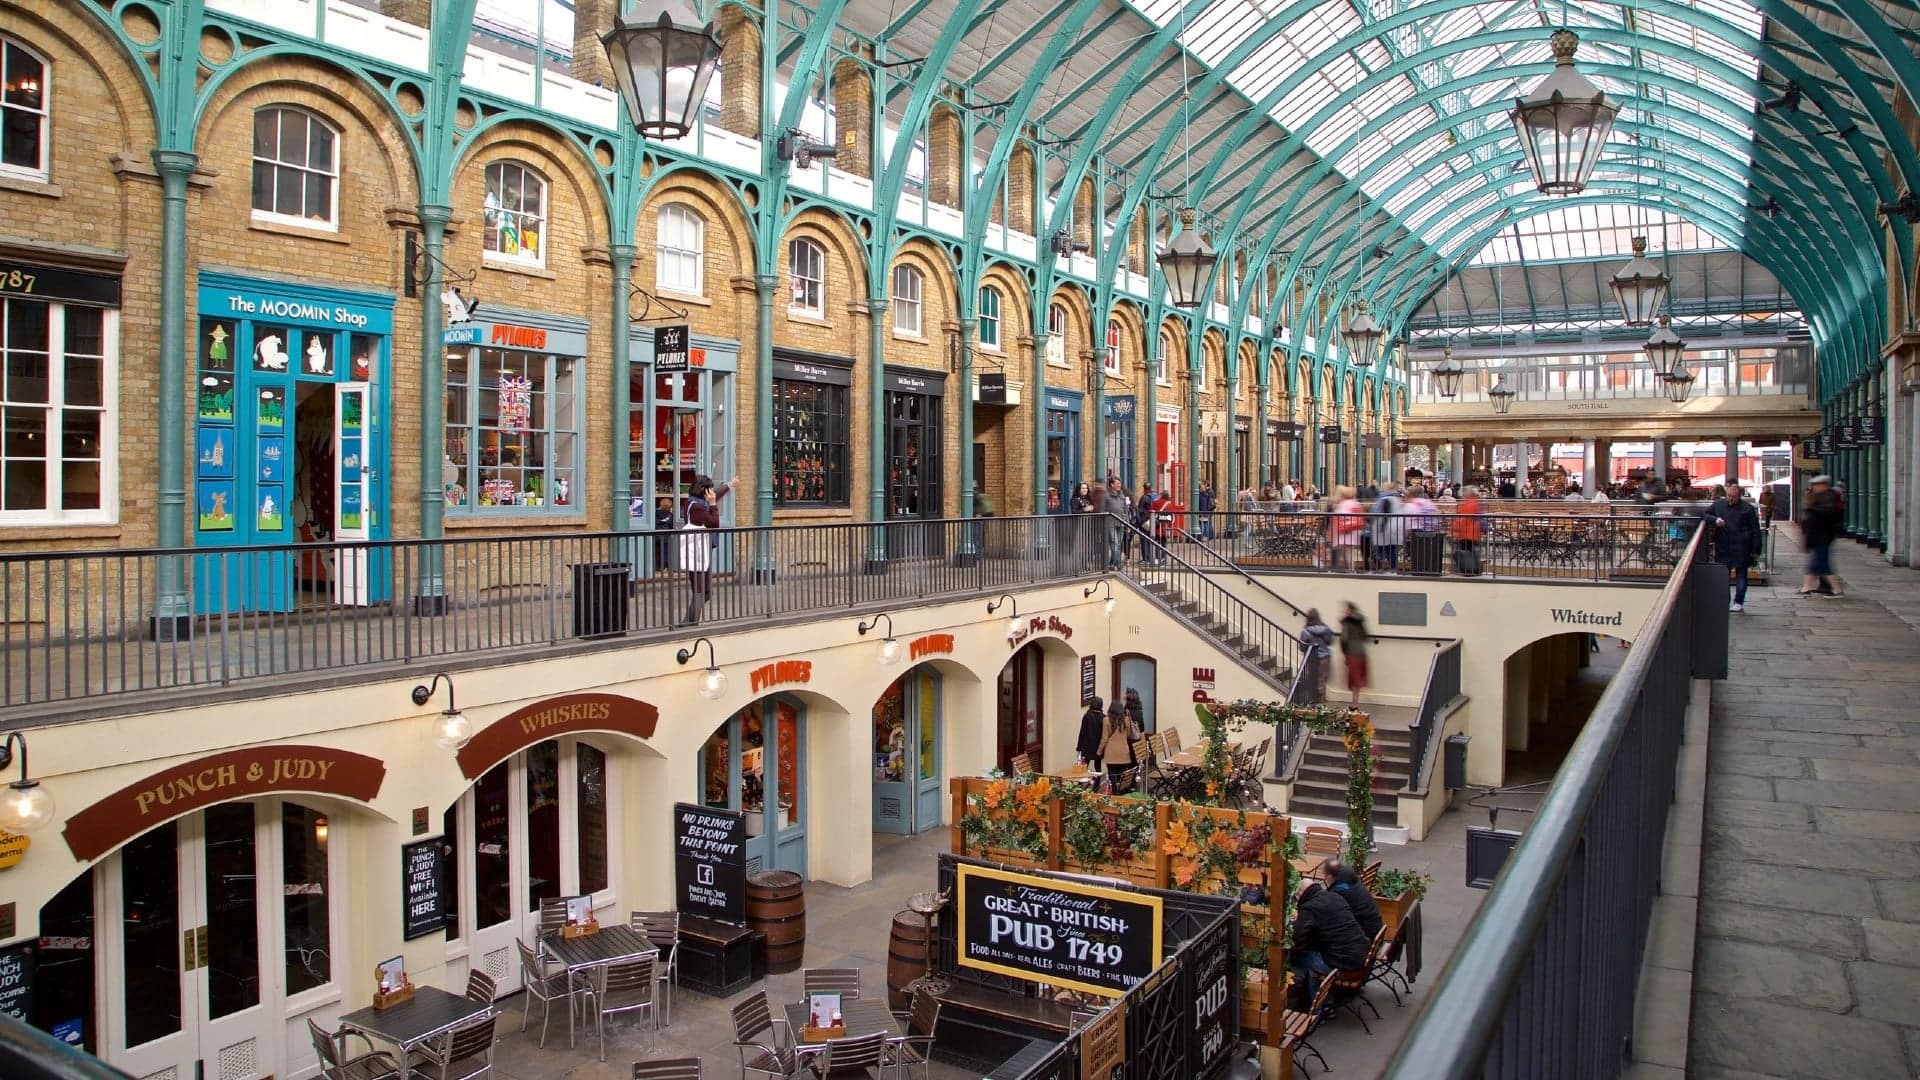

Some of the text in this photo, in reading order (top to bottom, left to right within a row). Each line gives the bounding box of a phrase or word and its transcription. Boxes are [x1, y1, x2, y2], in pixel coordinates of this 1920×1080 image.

[228, 295, 368, 328] The MOOMIN Shop
[491, 324, 547, 349] PYLONES
[657, 352, 686, 365] PYLONES
[1030, 617, 1046, 634] Pie
[1048, 615, 1073, 640] Shop
[1551, 608, 1622, 626] Whittard
[909, 634, 955, 662] PYLONES
[750, 660, 812, 694] PYLONES
[520, 703, 610, 735] WHISKIES
[134, 759, 335, 815] PUNCH & JUDY
[682, 813, 735, 830] NO DRINKS
[688, 825, 728, 840] BEYOND
[412, 851, 435, 865] PUNCH
[680, 836, 739, 855] THIS POINT
[408, 859, 435, 873] & JUDY
[413, 869, 432, 882] FREE
[409, 890, 438, 904] Available
[412, 900, 436, 917] HERE
[1018, 886, 1098, 910] Traditional
[984, 895, 1128, 933] GREAT BRITISH
[990, 914, 1055, 950] PUB
[1057, 925, 1085, 938] Since
[970, 942, 990, 955] FOOD
[991, 949, 1001, 957] ALL
[1032, 956, 1053, 969] ALES
[1057, 963, 1076, 971] CRAFT
[1078, 964, 1100, 978] BEERS
[1066, 937, 1122, 965] 1749
[1195, 975, 1228, 1030] PUB
[1203, 1028, 1223, 1065] 1749
